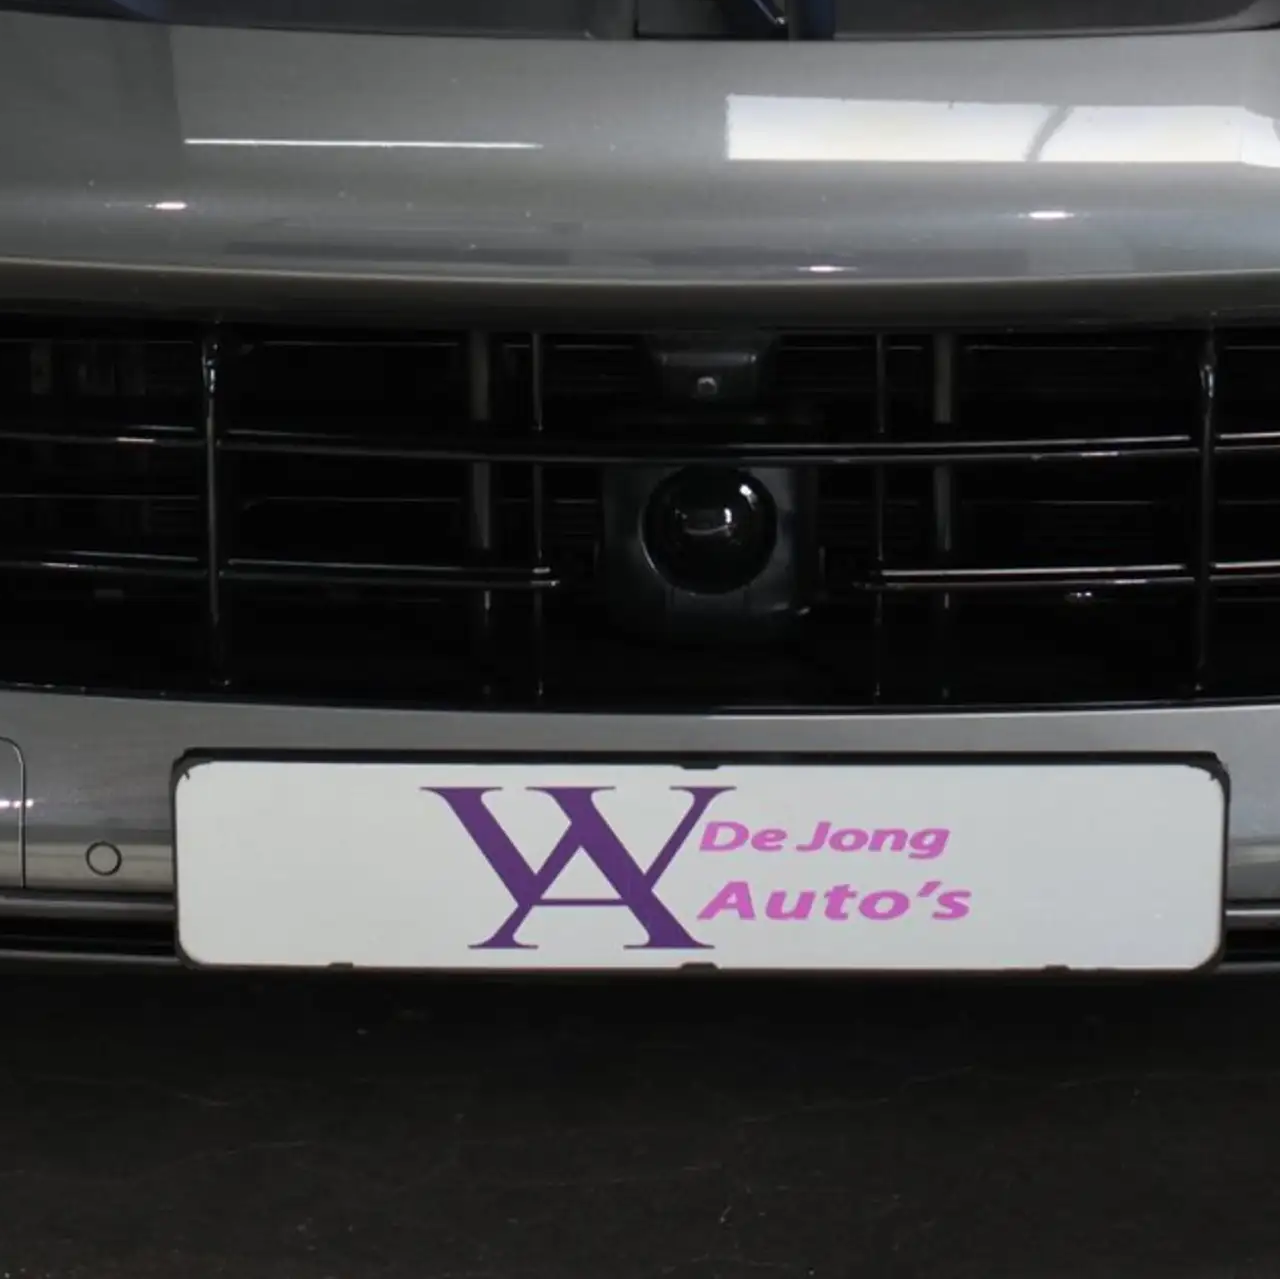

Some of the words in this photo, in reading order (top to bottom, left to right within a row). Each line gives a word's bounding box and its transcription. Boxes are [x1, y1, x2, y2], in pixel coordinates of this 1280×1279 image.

[699, 821, 790, 853] De
[795, 821, 951, 859] Jong
[697, 880, 972, 921] Auto's
